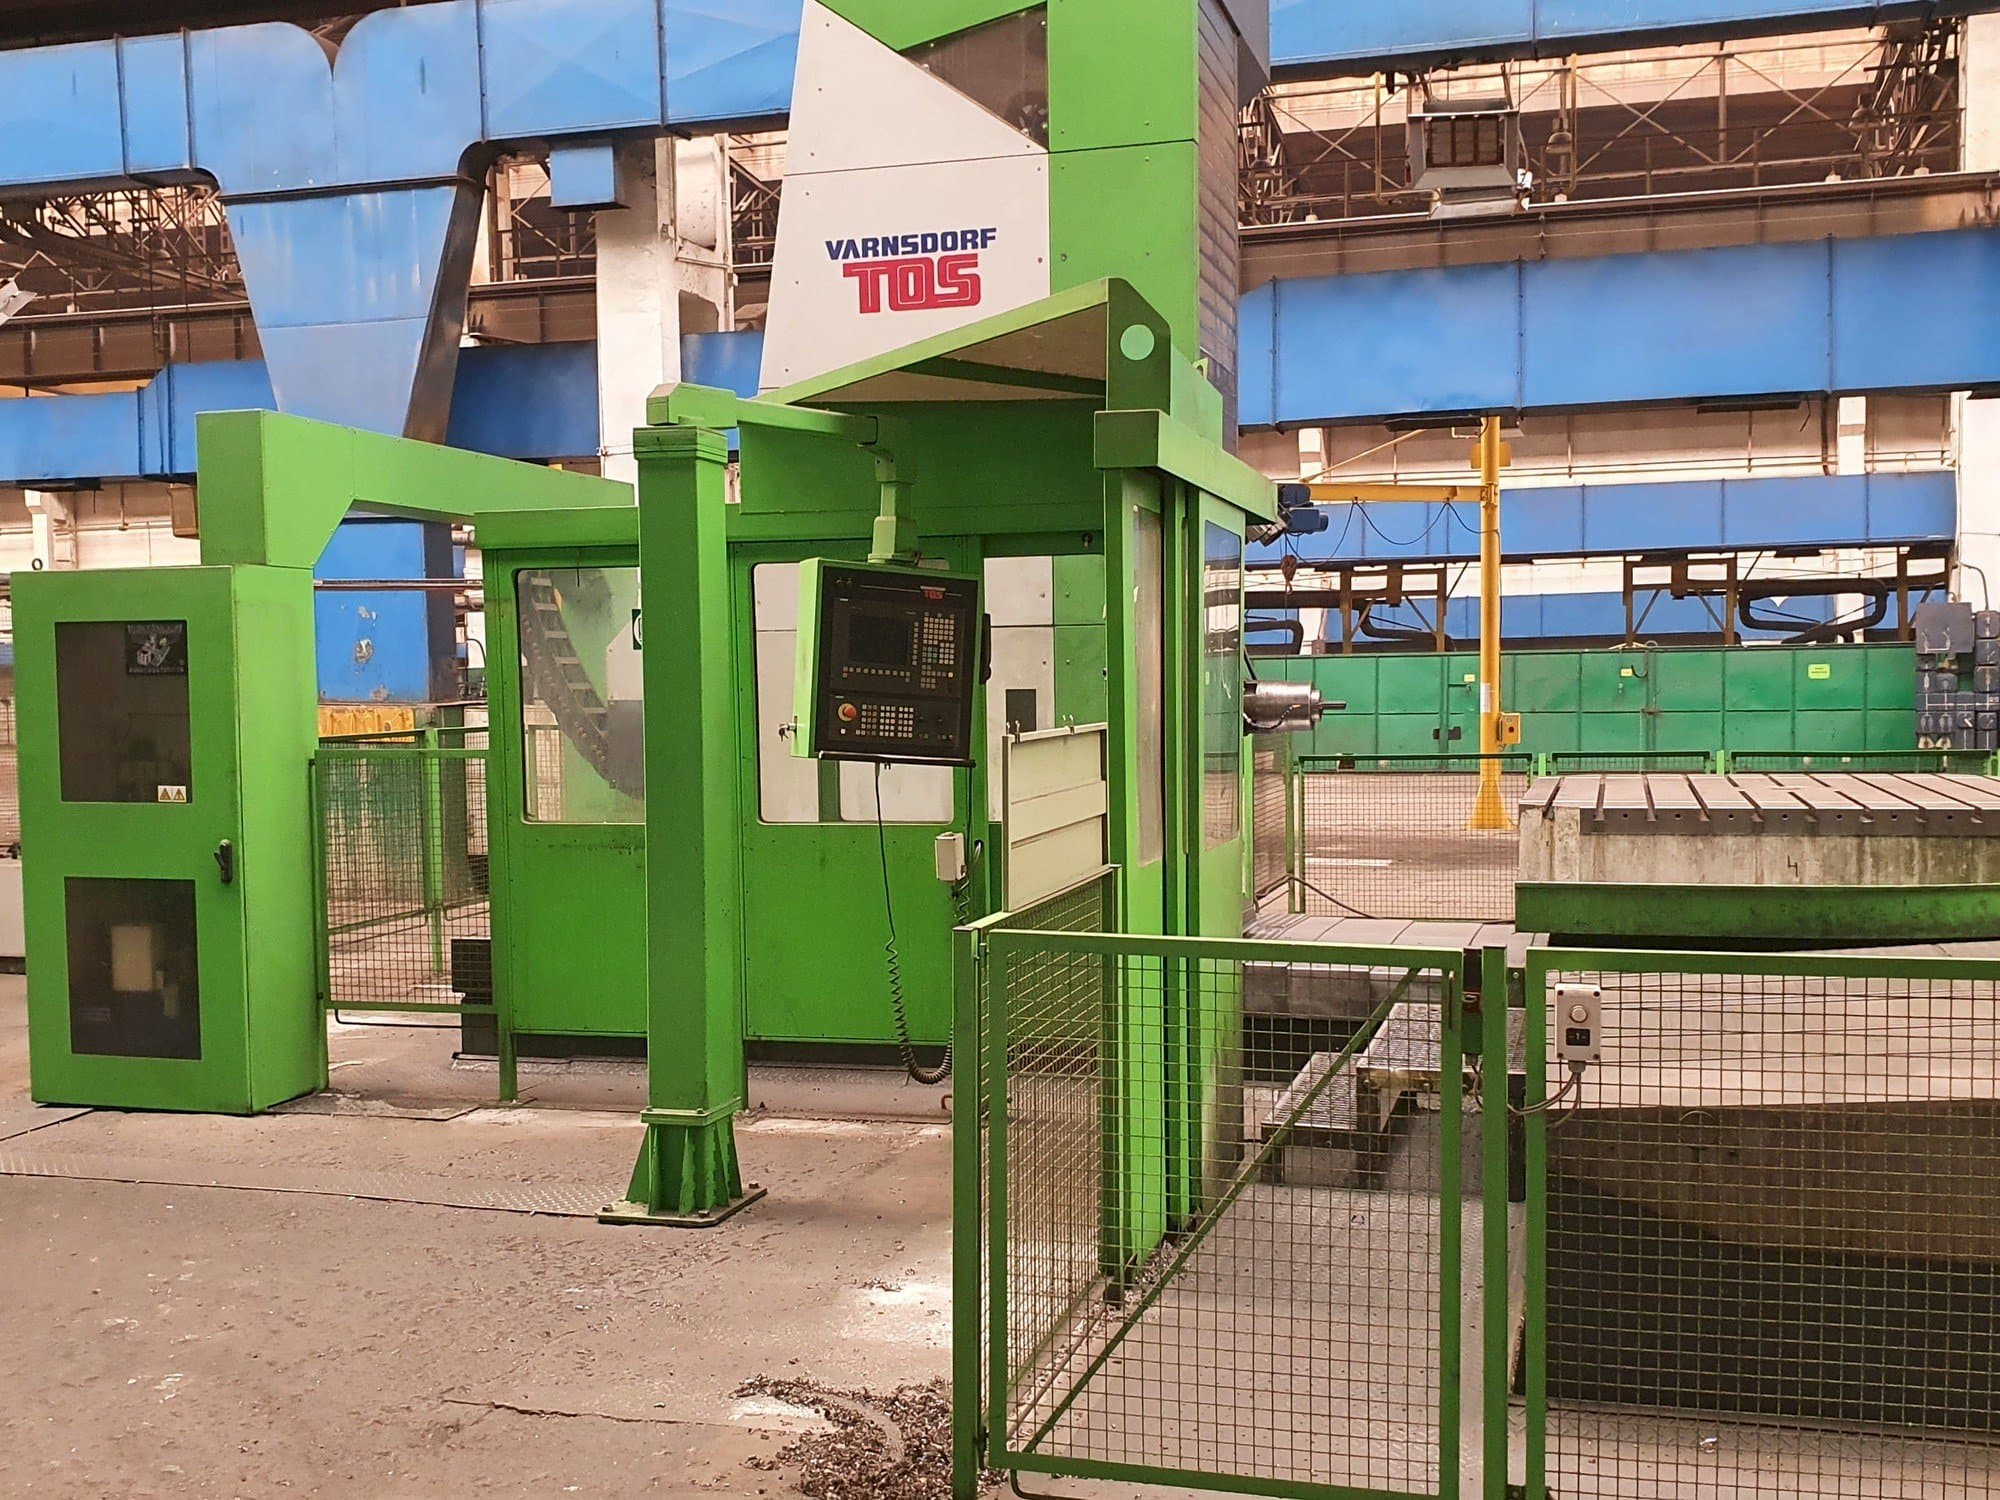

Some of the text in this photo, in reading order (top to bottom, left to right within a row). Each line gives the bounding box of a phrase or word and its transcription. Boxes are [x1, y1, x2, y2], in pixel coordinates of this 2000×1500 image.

[825, 227, 997, 260] VARNSDORF
[843, 253, 981, 314] TOS
[923, 590, 944, 600] TOS
